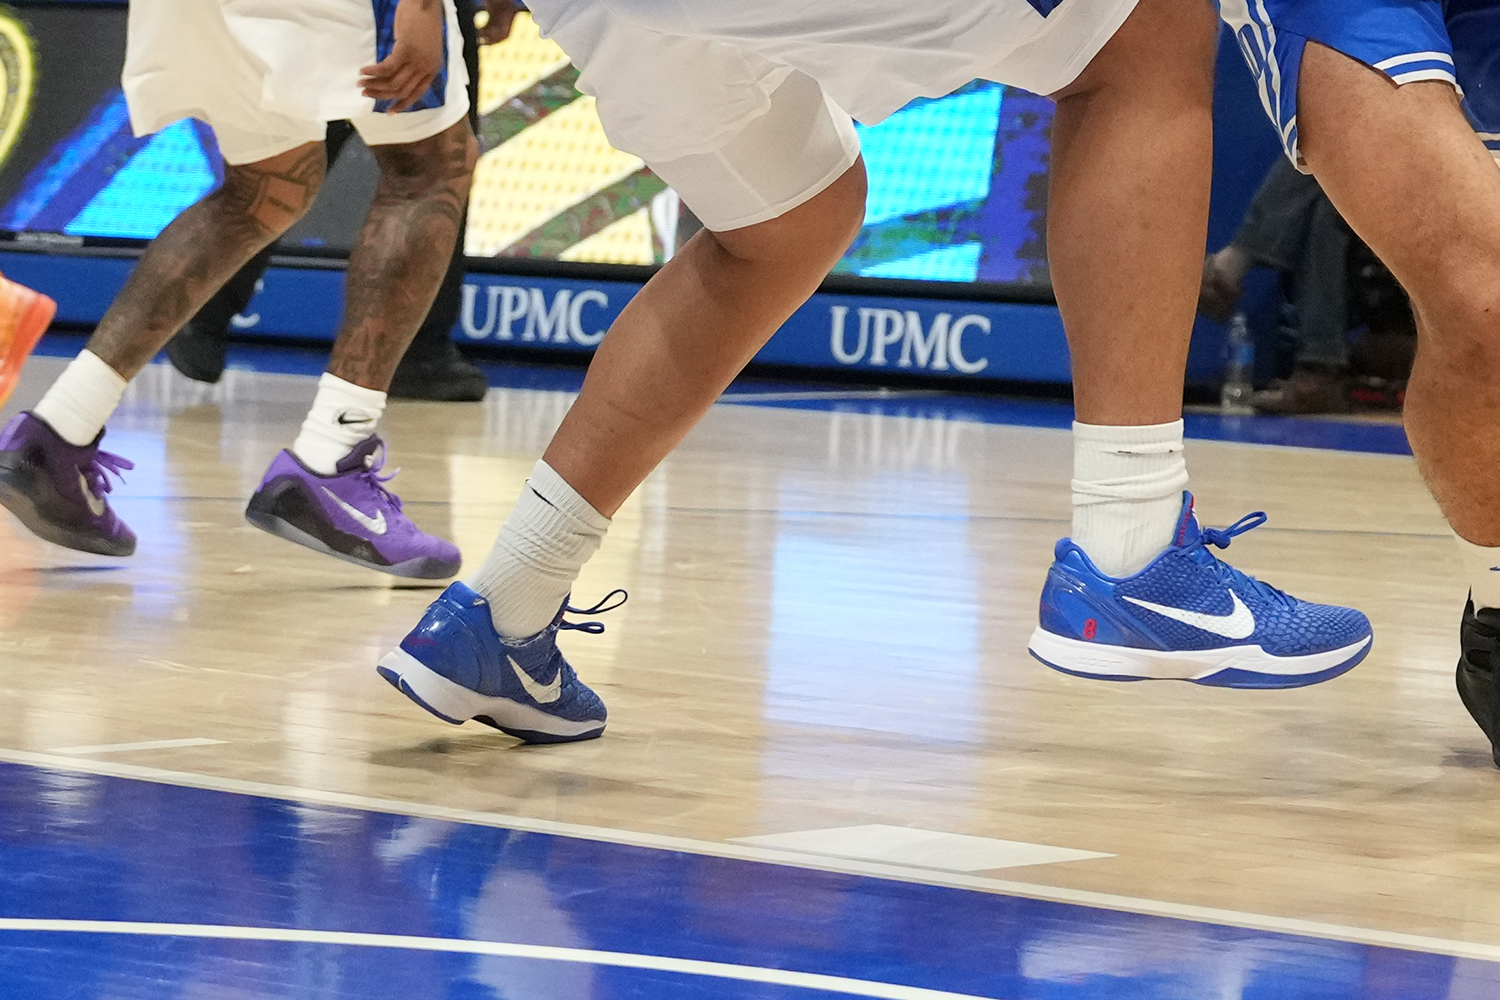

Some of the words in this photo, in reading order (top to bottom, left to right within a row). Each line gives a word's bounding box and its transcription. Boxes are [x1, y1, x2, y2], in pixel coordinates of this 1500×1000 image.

[461, 283, 609, 346] UPMC
[830, 305, 992, 374] UPMC
[1083, 618, 1097, 640] 8
